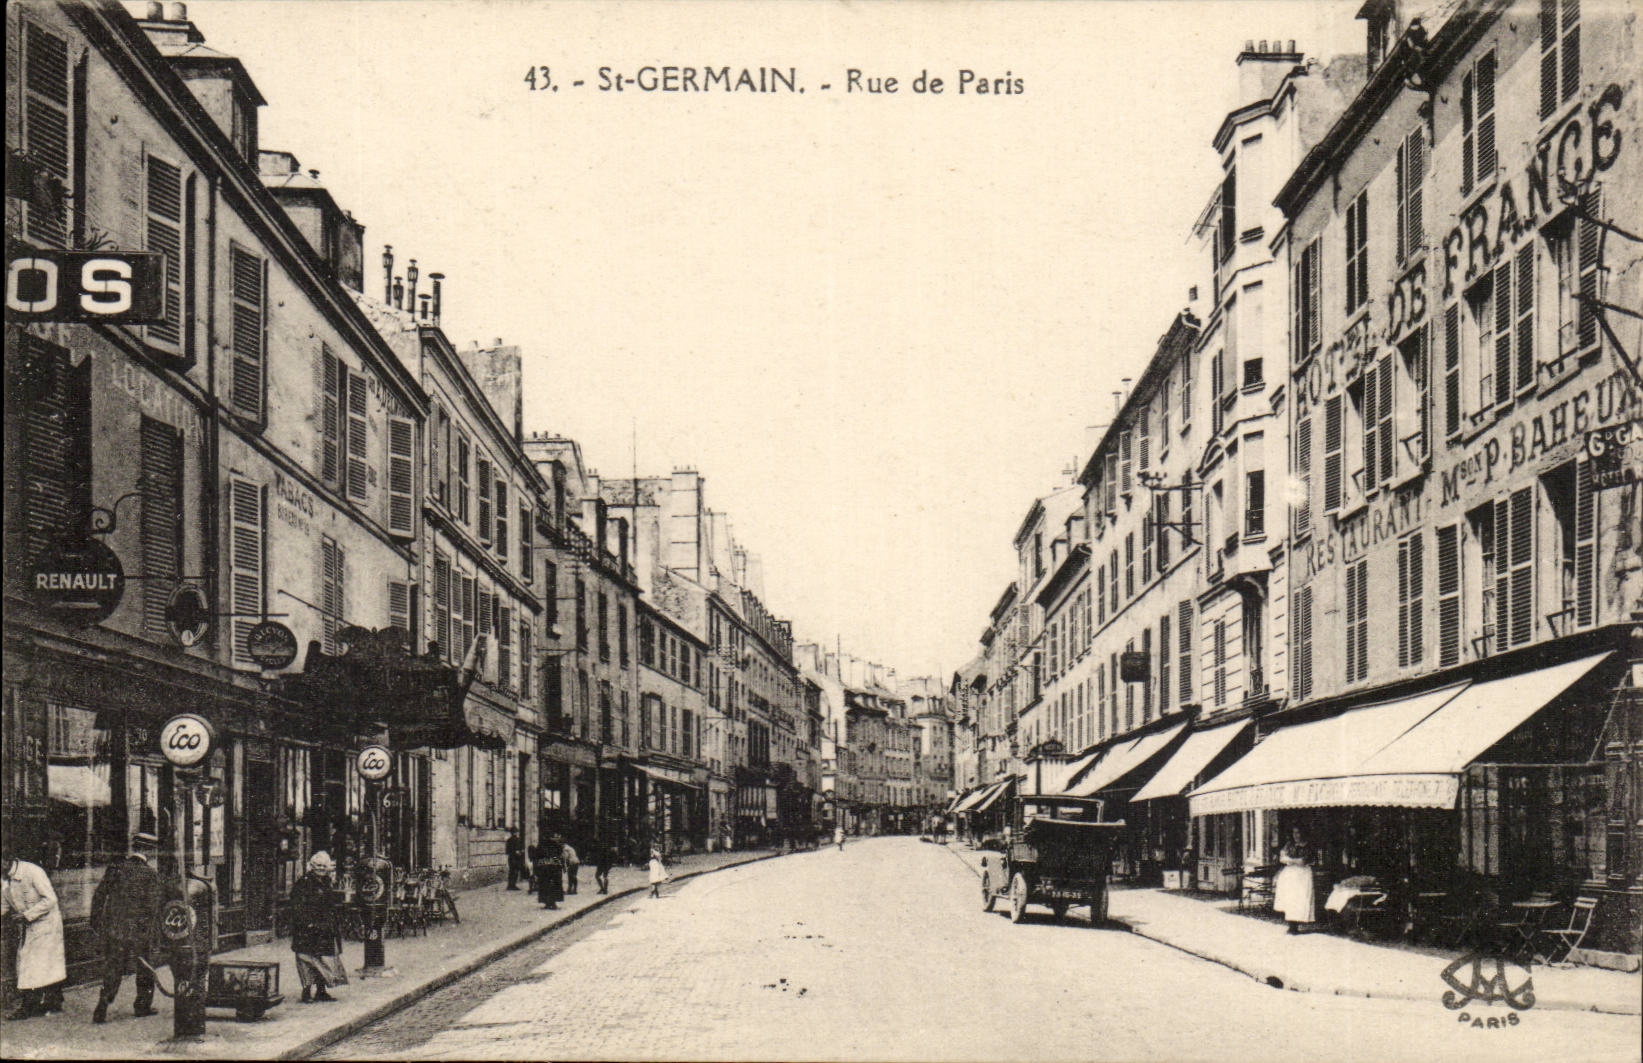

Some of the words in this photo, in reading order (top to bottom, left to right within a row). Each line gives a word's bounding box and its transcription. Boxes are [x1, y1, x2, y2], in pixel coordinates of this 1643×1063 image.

[1442, 84, 1622, 300] FRANCE
[36, 573, 118, 590] RENAULT
[168, 723, 201, 750] Eco
